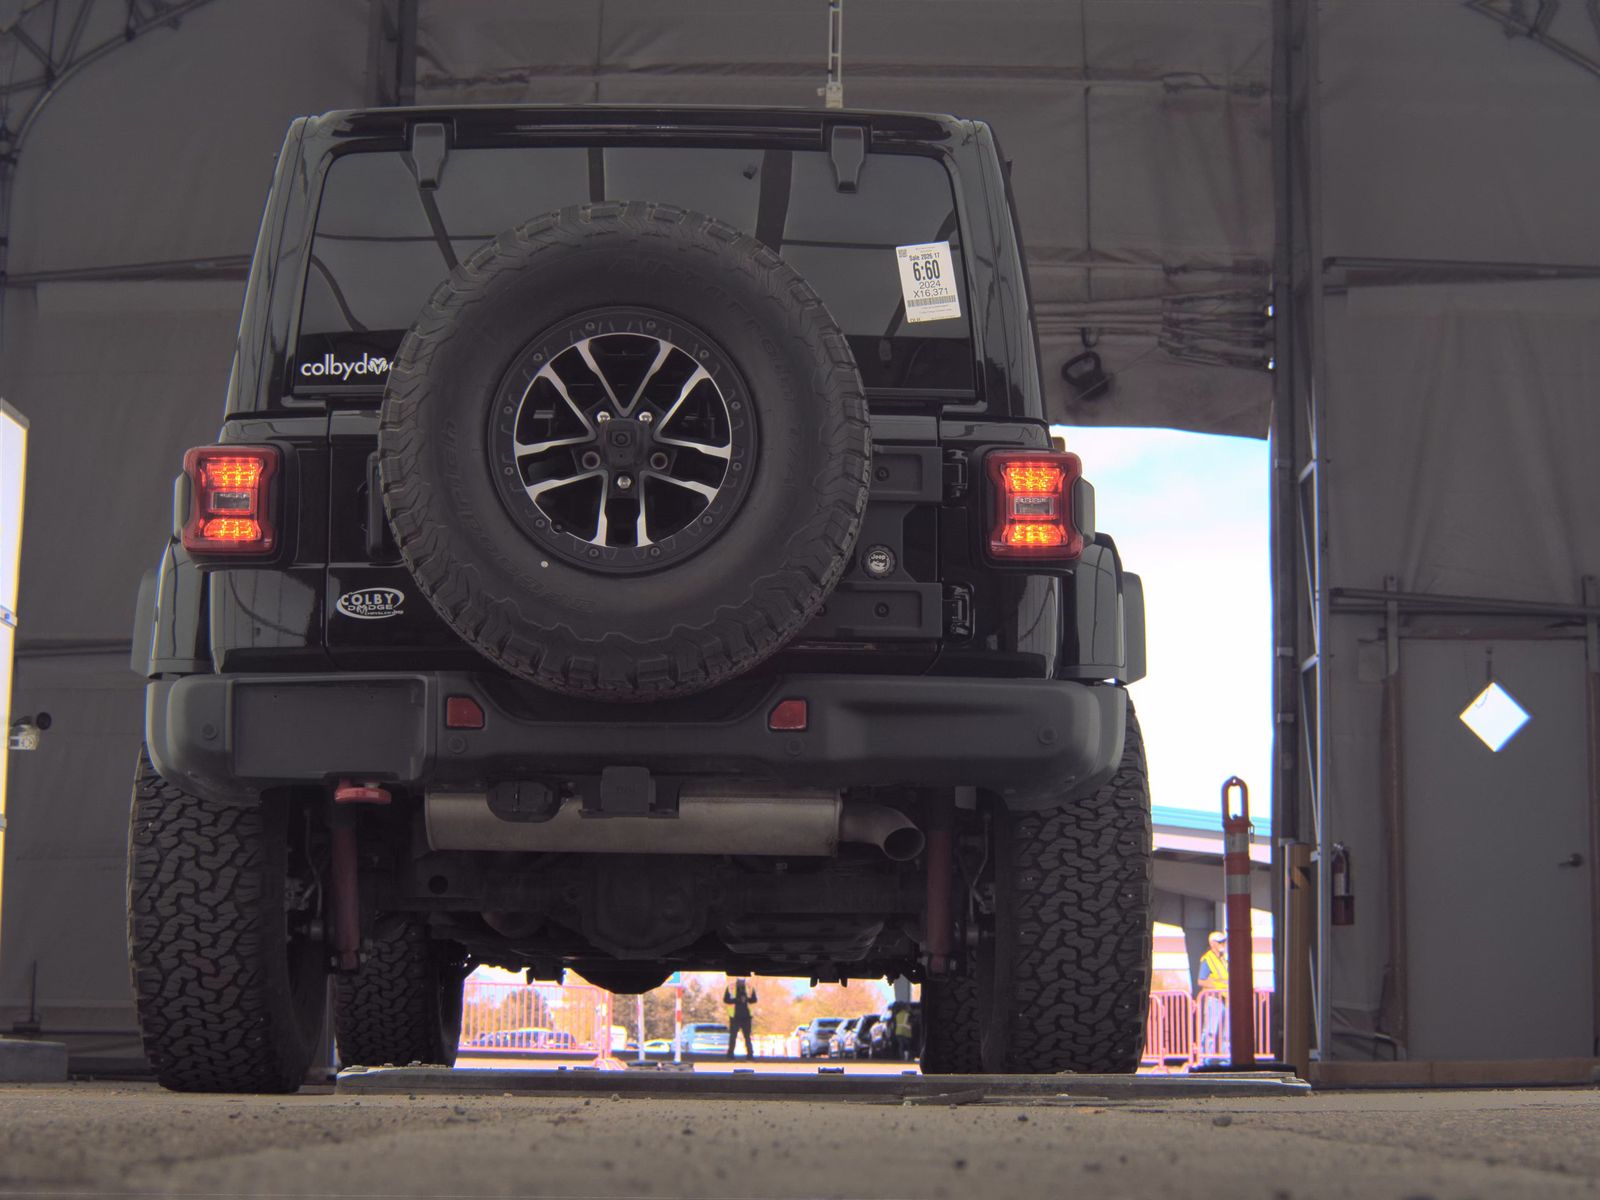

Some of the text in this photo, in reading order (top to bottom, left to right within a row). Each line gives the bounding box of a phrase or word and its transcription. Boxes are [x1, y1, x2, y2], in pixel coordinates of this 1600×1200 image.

[912, 259, 940, 281] 6:60
[919, 280, 941, 289] 2024
[341, 594, 394, 605] COLBY
